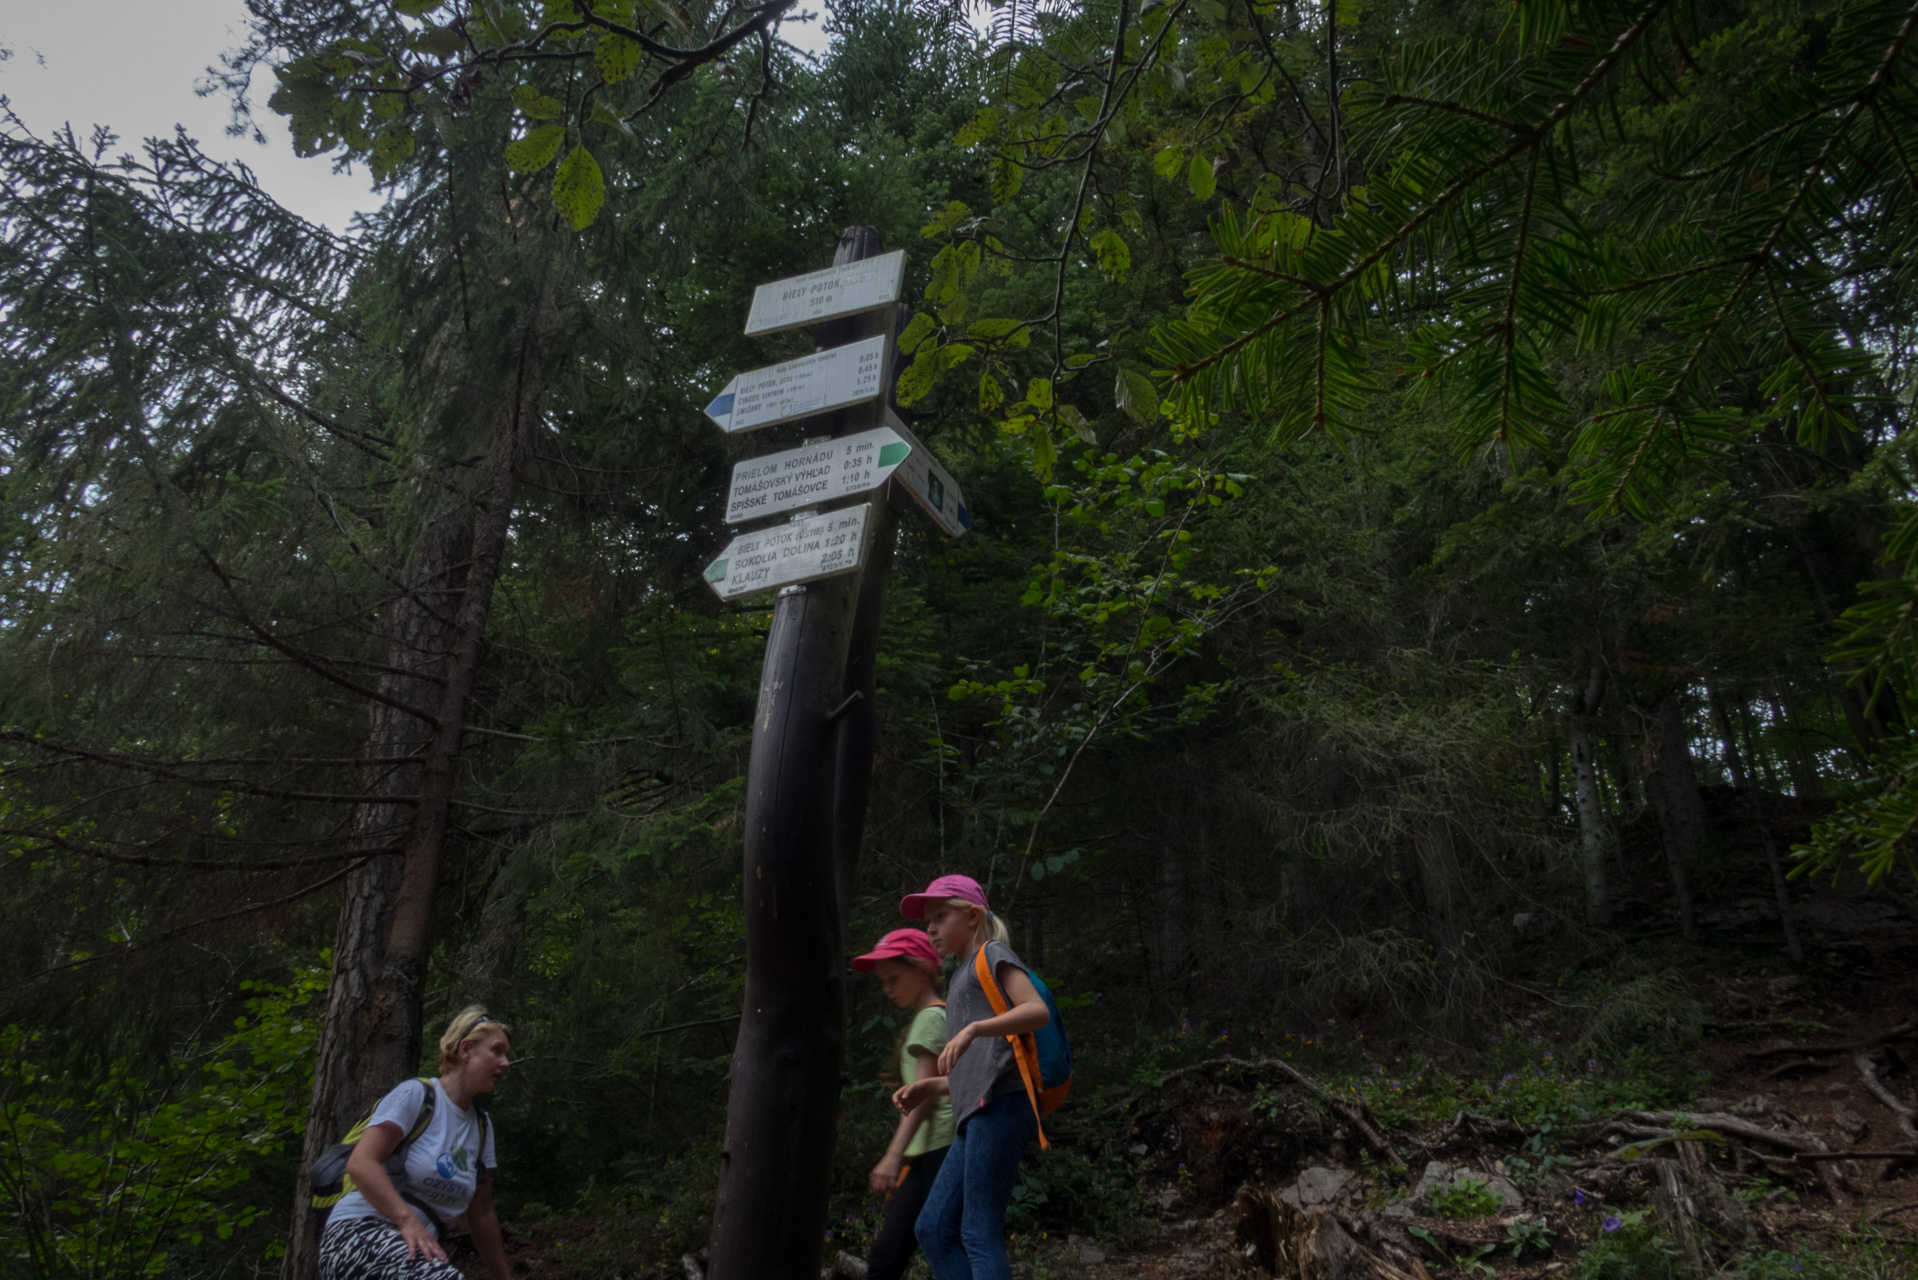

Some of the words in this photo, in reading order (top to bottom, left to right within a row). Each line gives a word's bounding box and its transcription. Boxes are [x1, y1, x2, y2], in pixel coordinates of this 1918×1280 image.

[782, 287, 807, 301] BIELY
[810, 296, 823, 306] 510
[858, 364, 872, 374] 0:45
[740, 386, 755, 395] BIELY
[846, 445, 852, 455] 5
[856, 441, 874, 453] min.
[735, 464, 778, 482] PRIELOM
[784, 450, 834, 470] HORNÁDU
[844, 457, 862, 470] 0:35
[866, 455, 872, 464] h
[734, 472, 793, 497] TOMÁŠOVSKÝ
[795, 465, 831, 482] VÝHĽAD
[842, 472, 860, 485] 1:10
[864, 470, 870, 479] h
[731, 493, 768, 512] SPIŠSKÉ
[773, 480, 828, 502] TOMÁŠOVCE
[729, 512, 743, 521] 2000
[827, 522, 834, 532] 5
[839, 517, 860, 529] min.
[738, 540, 761, 555] BIELY
[764, 532, 793, 548] POTOK
[825, 534, 846, 548] 1:20
[851, 531, 857, 541] h
[734, 551, 777, 570] SOKOLIA
[783, 540, 820, 558] DOLINA
[821, 549, 843, 564] 2:05
[848, 547, 854, 558] h
[731, 567, 771, 586] KLAUZY
[422, 1177, 469, 1197] CZYSTE
